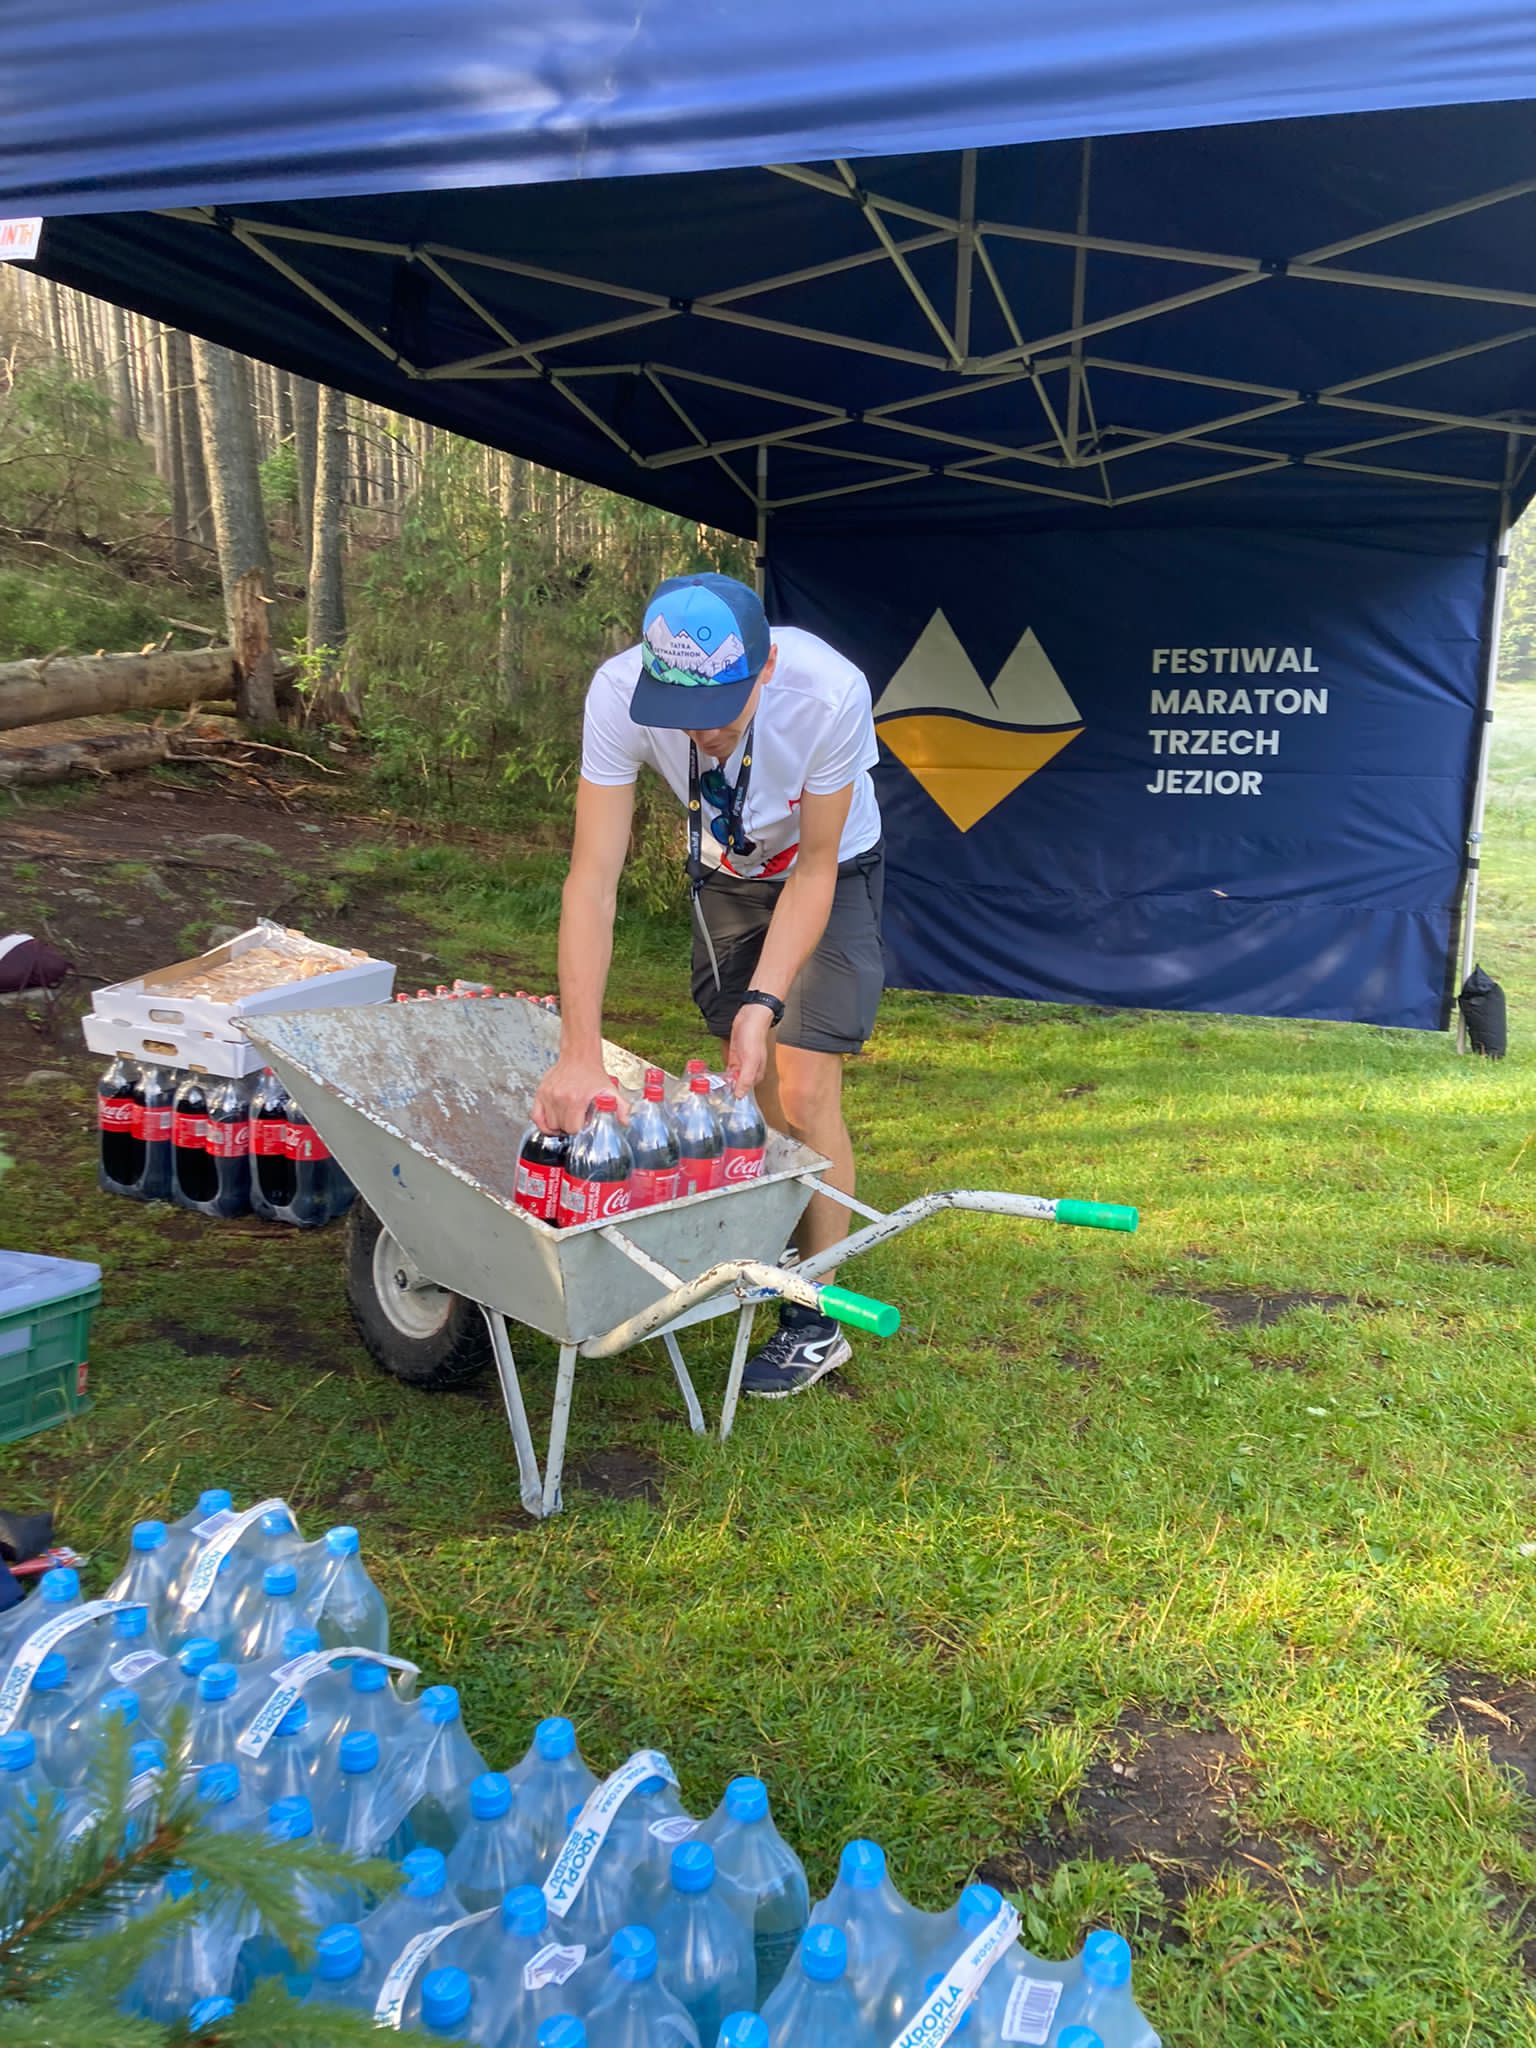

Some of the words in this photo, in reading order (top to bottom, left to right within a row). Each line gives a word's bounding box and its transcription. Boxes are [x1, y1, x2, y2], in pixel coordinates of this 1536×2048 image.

[1152, 647, 1320, 674] FESTIWAL
[1151, 688, 1329, 715] MARATON
[1148, 729, 1280, 755] TRZECH
[1146, 769, 1263, 795] JEZIOR
[549, 1830, 583, 1890] BESKIDU
[553, 1827, 601, 1901] KROPLA
[900, 1984, 964, 2048] KROPLA
